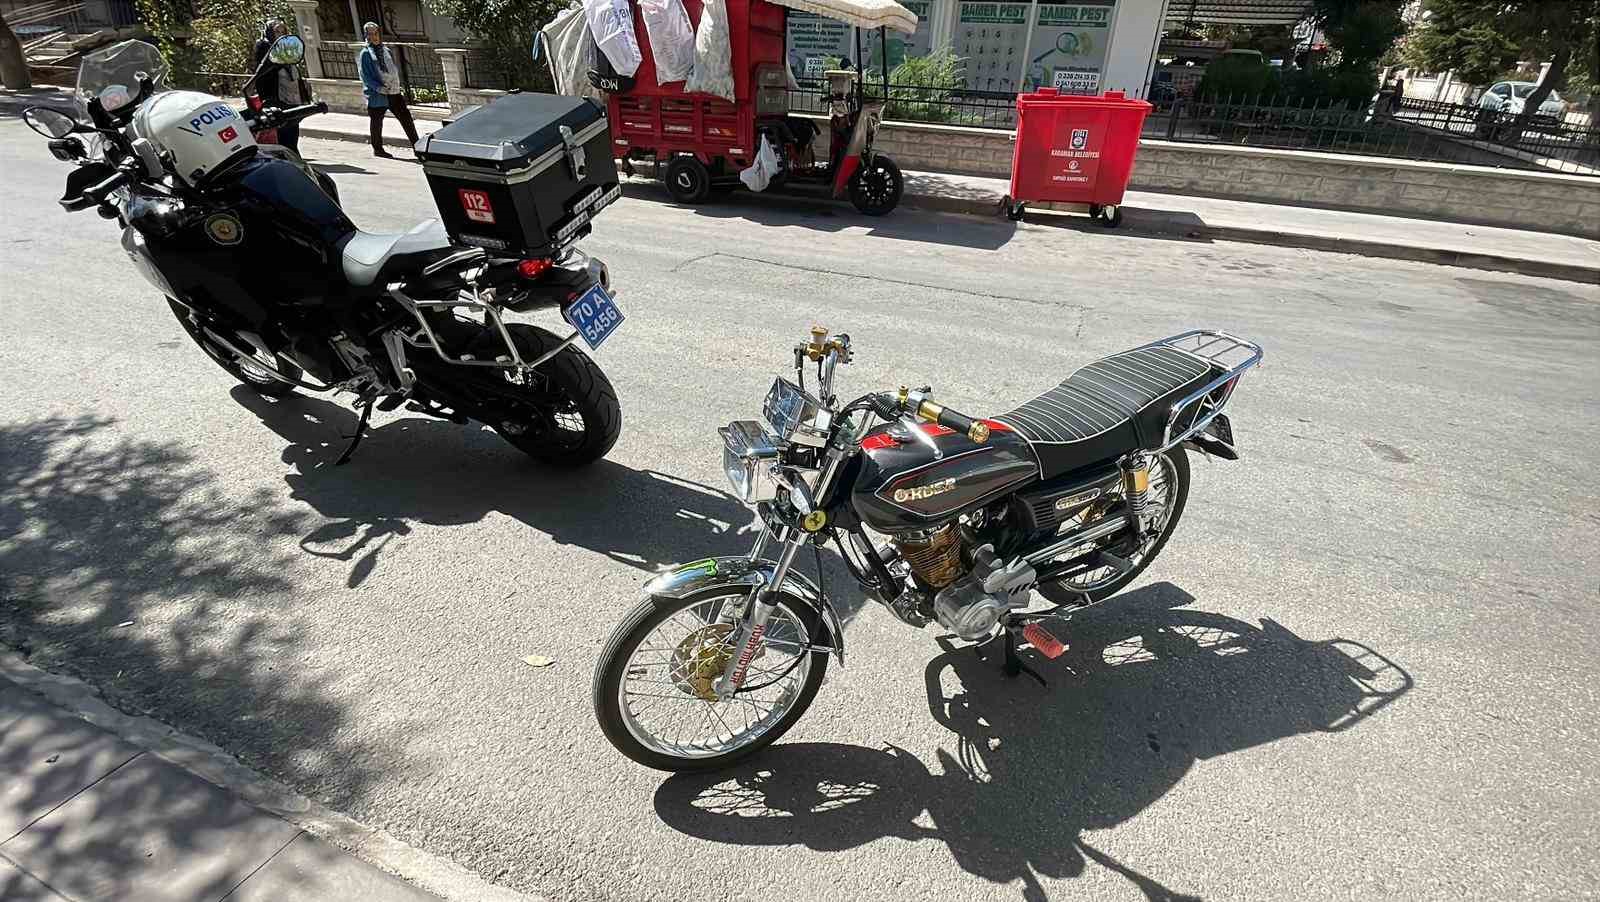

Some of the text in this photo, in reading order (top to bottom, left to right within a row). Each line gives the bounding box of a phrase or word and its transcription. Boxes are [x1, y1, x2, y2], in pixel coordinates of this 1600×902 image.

[999, 5, 1026, 18] PEST
[1040, 5, 1108, 21] BAMER PEST
[464, 193, 488, 210] 112
[572, 293, 606, 324] 70 A
[585, 306, 617, 341] 5456
